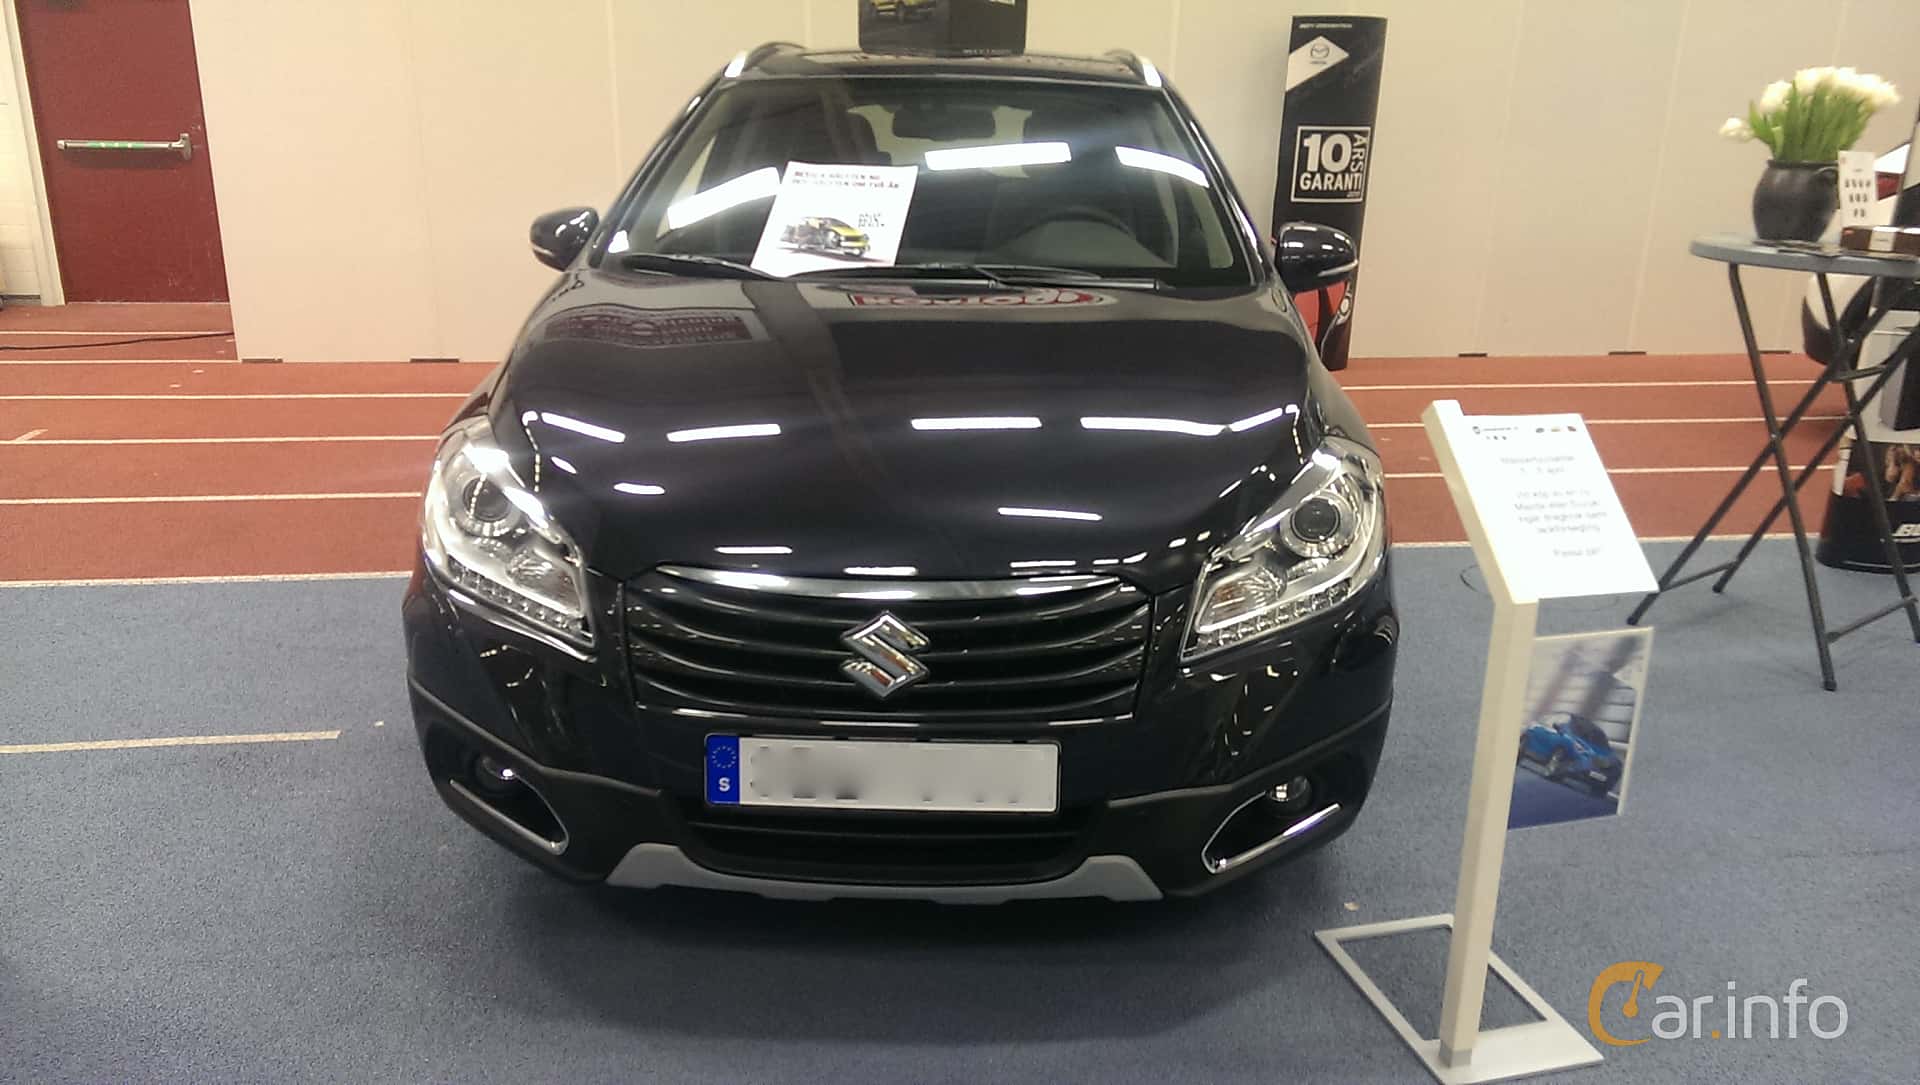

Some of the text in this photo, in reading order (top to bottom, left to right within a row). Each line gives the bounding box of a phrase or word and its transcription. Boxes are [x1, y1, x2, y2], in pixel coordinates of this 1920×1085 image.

[1303, 133, 1352, 173] 10
[1300, 172, 1362, 191] GARANTI
[719, 777, 730, 792] S
